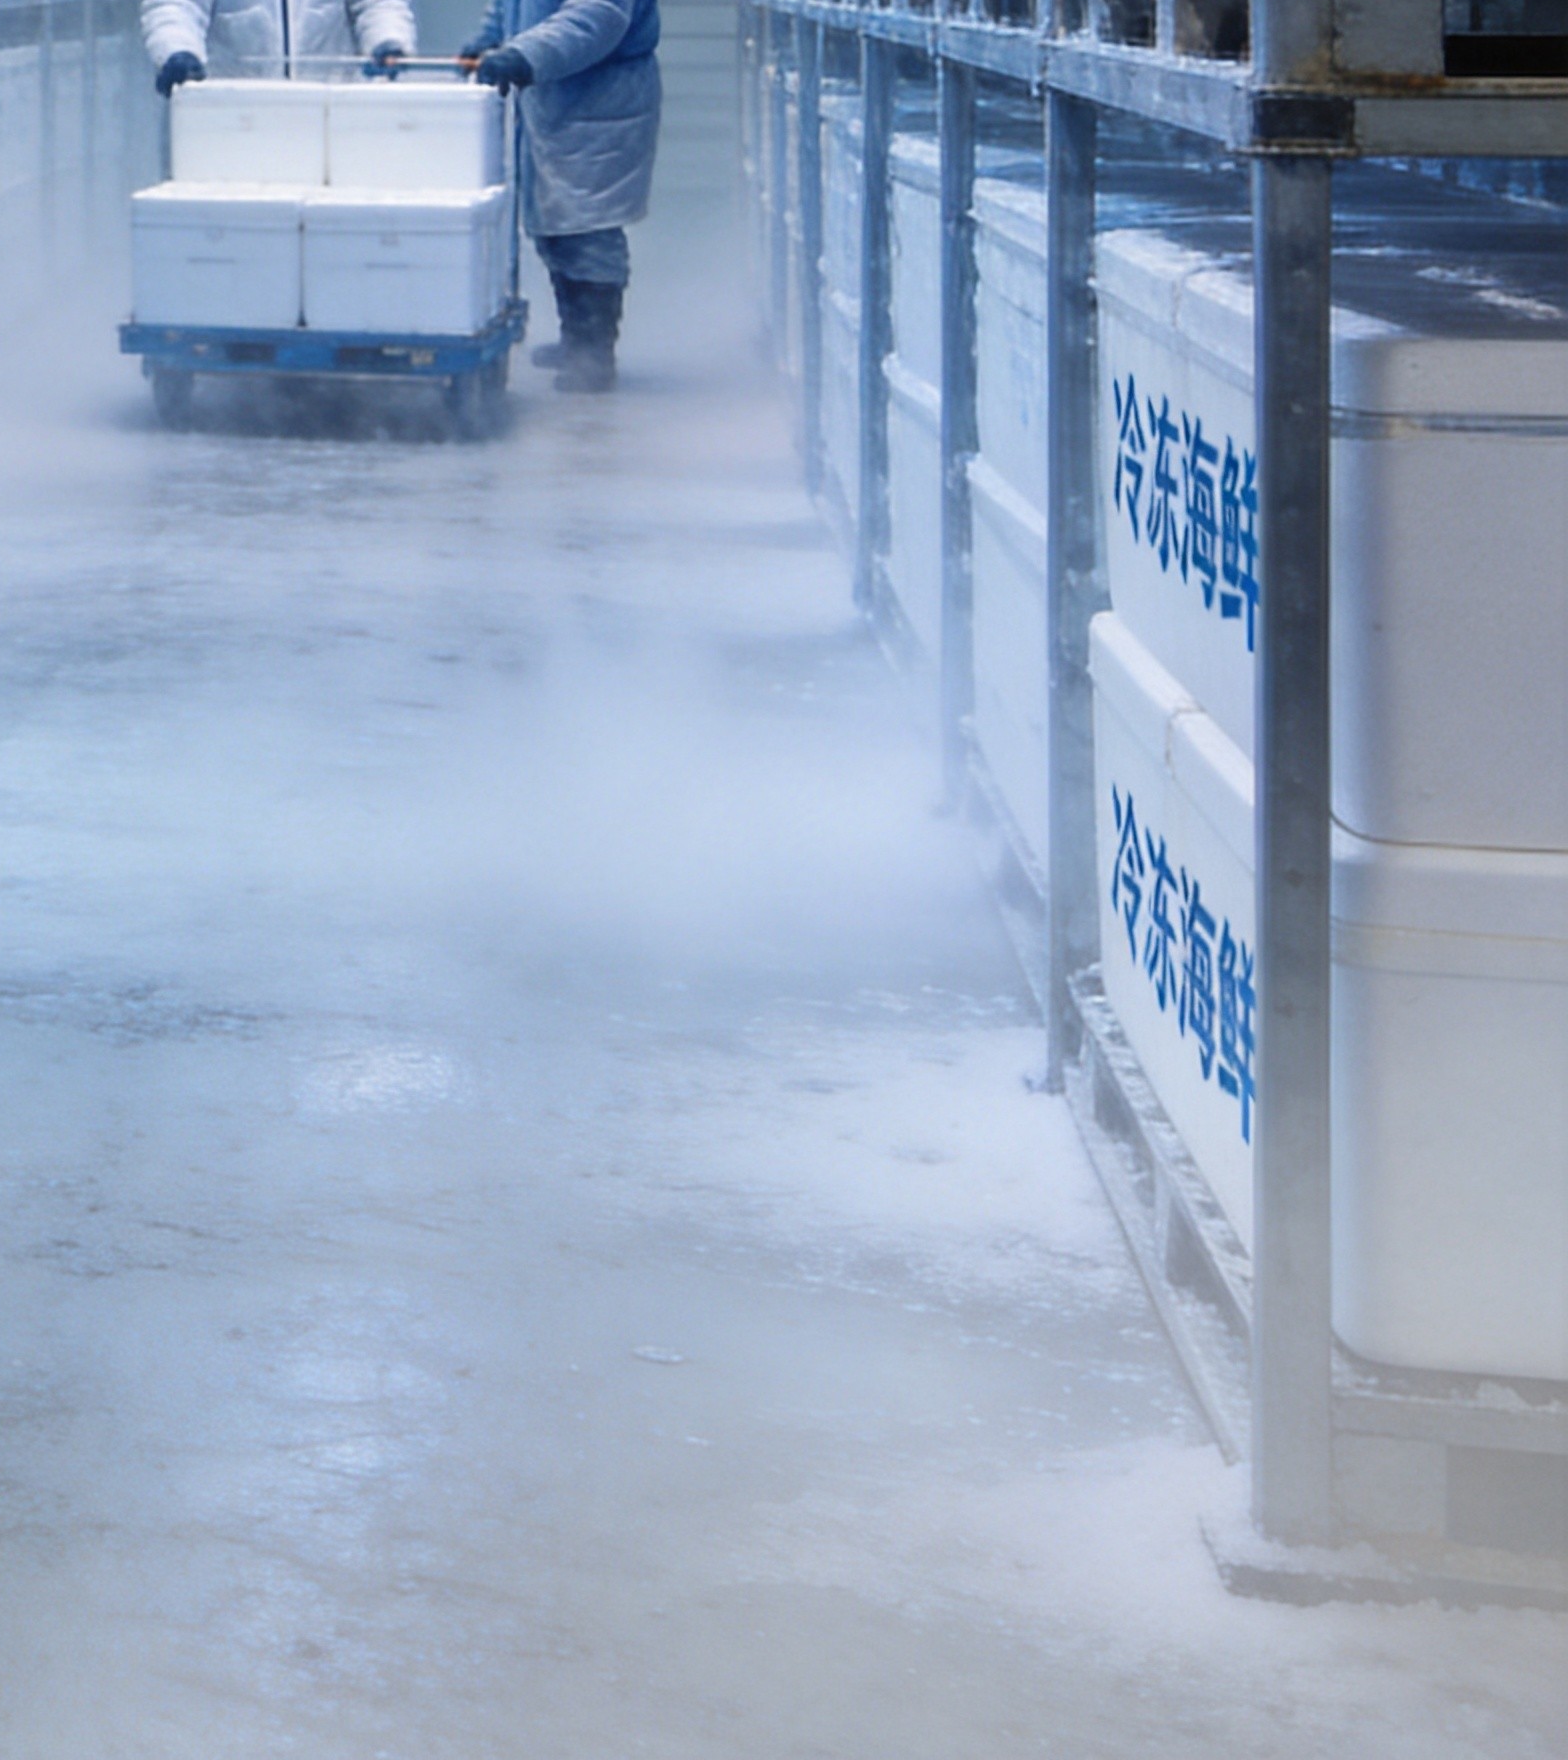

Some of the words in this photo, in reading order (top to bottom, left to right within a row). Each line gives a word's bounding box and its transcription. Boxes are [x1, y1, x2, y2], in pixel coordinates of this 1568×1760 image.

[1112, 373, 1259, 652] 冷冻海鲜
[1112, 784, 1256, 1144] 冷冻海鲜
